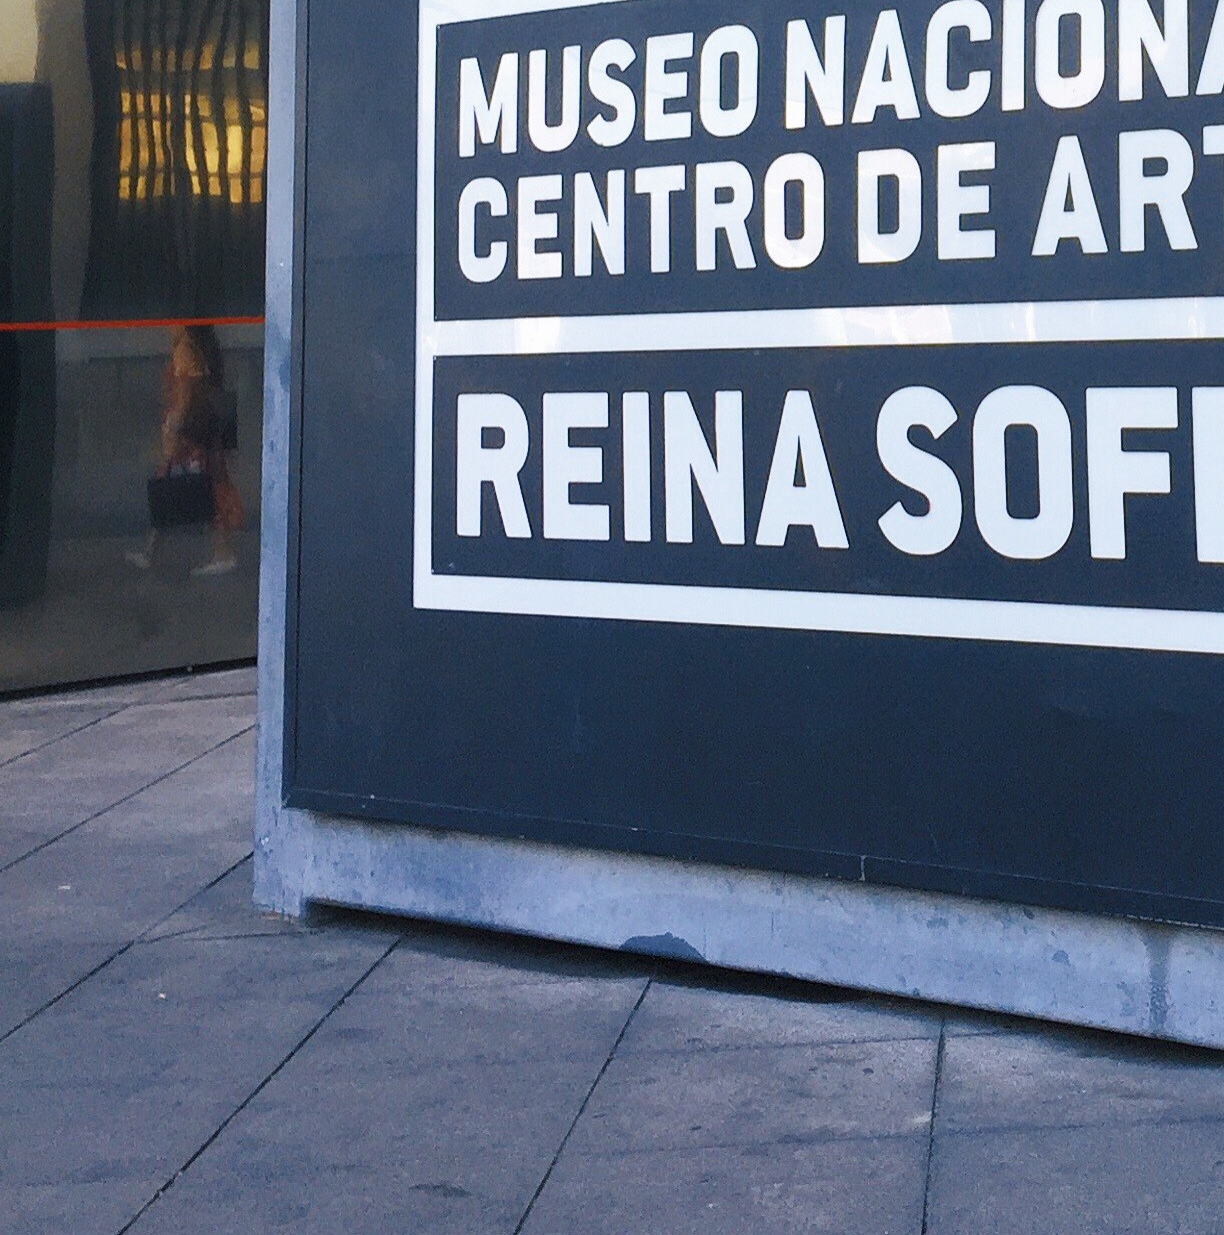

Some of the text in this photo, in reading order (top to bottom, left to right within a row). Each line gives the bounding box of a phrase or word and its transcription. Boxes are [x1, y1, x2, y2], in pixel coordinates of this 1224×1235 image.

[457, 24, 759, 158] MUSEO
[457, 152, 825, 283] CENTRO
[857, 141, 996, 264] DE
[456, 390, 850, 549] REINA
